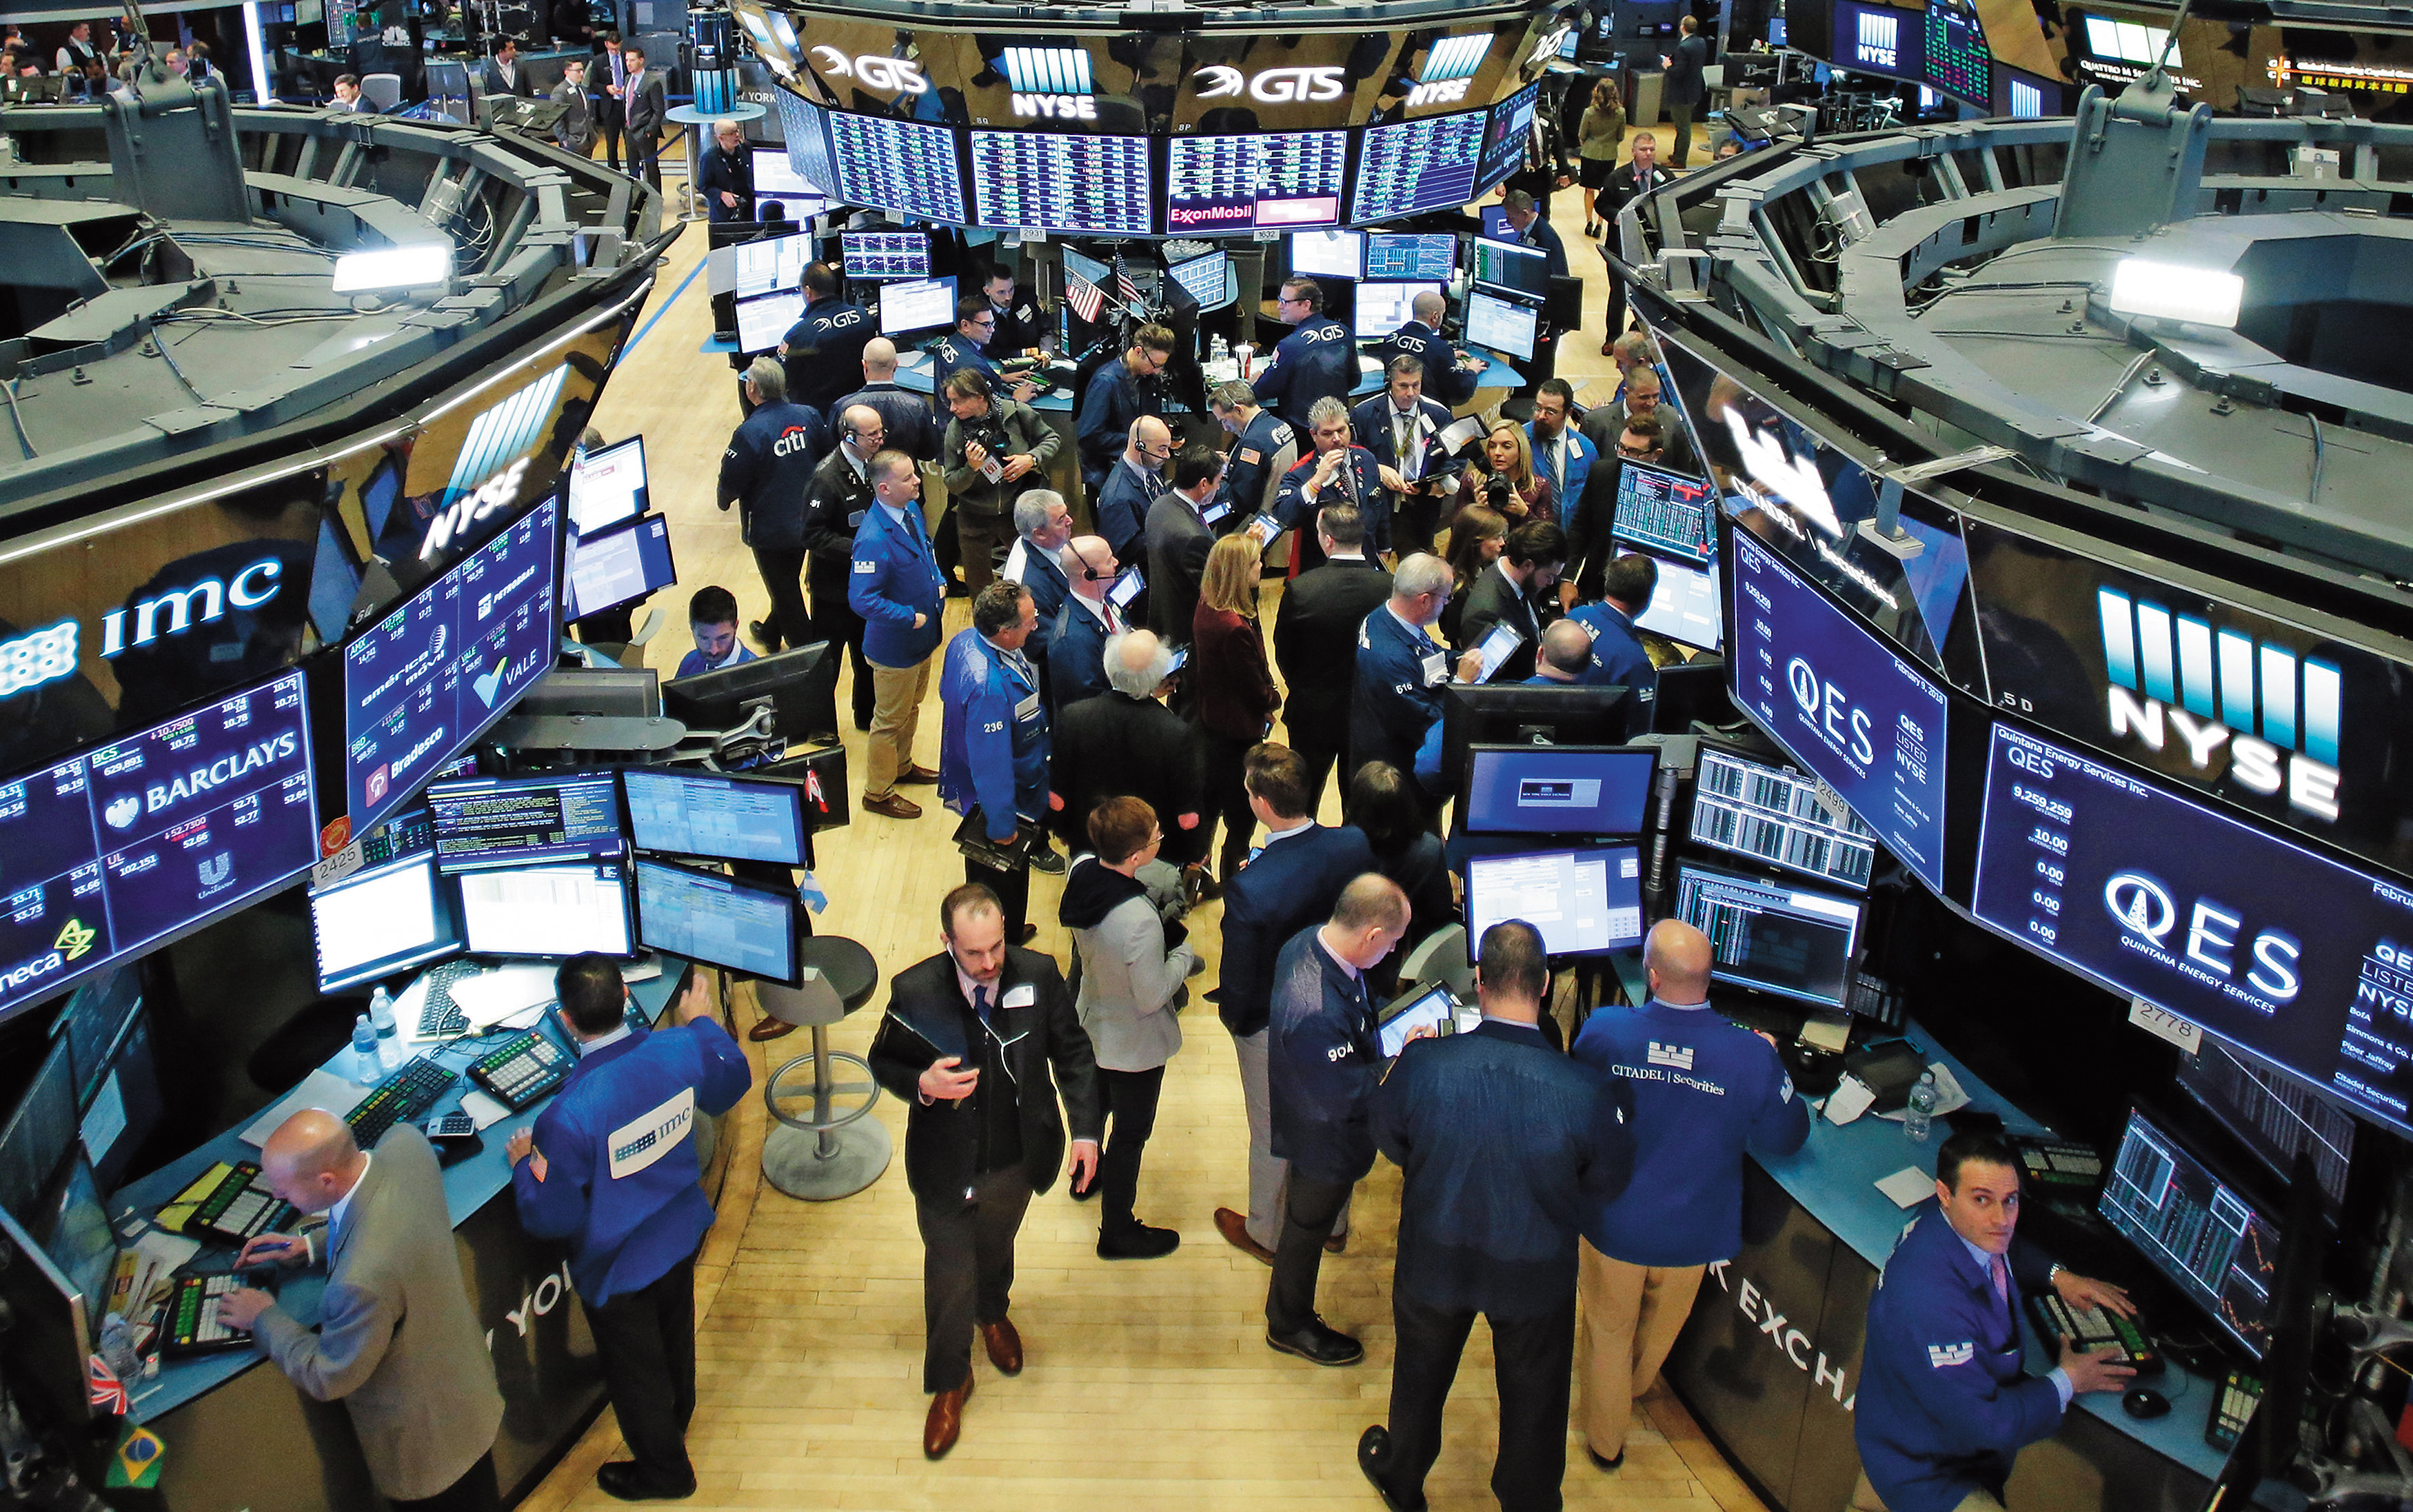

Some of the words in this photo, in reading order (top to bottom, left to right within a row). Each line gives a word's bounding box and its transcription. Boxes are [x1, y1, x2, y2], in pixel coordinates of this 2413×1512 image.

[1858, 44, 1897, 67] NYSE
[855, 54, 928, 94] GTS
[1249, 66, 1346, 101] GTS
[748, 91, 776, 103] YORK
[1406, 78, 1471, 106] NYSE
[1011, 92, 1097, 119] NYSE
[1170, 204, 1253, 224] ExxonMobil
[833, 310, 860, 327] GTS
[1320, 324, 1344, 341] GTS
[941, 343, 960, 364] GTS
[1397, 336, 1426, 353] GTS
[774, 430, 806, 457] citi
[419, 457, 529, 560] NYSE
[1730, 475, 1806, 541] CITADEL
[1816, 538, 1898, 610] Securities
[1740, 546, 1761, 574] QES
[1756, 618, 1772, 638] 10.00
[350, 637, 367, 656] AMX
[1759, 648, 1773, 665] 0.00
[506, 648, 537, 685] VALE
[1895, 659, 1920, 687] February
[273, 677, 298, 694] 10.75
[1760, 675, 1773, 692] 0.00
[221, 696, 247, 713] 10.74
[274, 693, 299, 709] 10.71
[1760, 701, 1773, 718] 0.00
[1788, 657, 1875, 765] QES
[157, 716, 194, 738] 10.7500
[223, 713, 249, 729] 10.78
[984, 720, 1004, 733] 236
[1900, 714, 1924, 742] QES
[169, 734, 196, 751] 10.72
[1896, 731, 1927, 763] LISTED
[2108, 683, 2341, 819] NYSE
[91, 747, 119, 765] BCS
[391, 727, 443, 780] Bradesco
[1998, 728, 2043, 754] Quintana
[2045, 747, 2081, 770] Energy
[2083, 763, 2126, 789] Services
[2129, 782, 2148, 798] Inc.
[2008, 746, 2054, 779] QES
[52, 760, 81, 778] 39.32
[103, 755, 143, 776] 629,891
[147, 732, 296, 814] BARCLAYS
[1897, 749, 1926, 785] NYSE
[56, 778, 84, 795] 39.19
[283, 772, 307, 789] 52.74
[232, 794, 259, 811] 52.71
[283, 789, 307, 805] 52.64
[1819, 783, 1845, 812] 2499
[2013, 785, 2072, 818] 9,259,259
[170, 816, 206, 837] 52.7300
[234, 809, 259, 827] 52.77
[183, 831, 209, 849] 52.66
[2035, 828, 2068, 851] 10.00
[108, 853, 125, 865] UL
[119, 854, 158, 877] 102,151
[319, 847, 356, 880] 2425
[2037, 861, 2064, 881] 0.00
[12, 887, 40, 906] 33.71
[72, 878, 101, 897] 33.66
[2034, 891, 2060, 911] 0.00
[14, 903, 43, 923] 33.73
[2030, 920, 2056, 940] 0.00
[2105, 874, 2299, 998] QES
[2375, 945, 2413, 971] QE
[2121, 936, 2175, 967] QUINTANA
[2178, 962, 2222, 987] ENERGY
[2223, 983, 2275, 1014] SERVICES
[2140, 1002, 2192, 1037] 2778
[2349, 1006, 2371, 1022] BofA
[2345, 1023, 2385, 1047] Simmons
[2385, 1042, 2393, 1051] &
[2394, 1046, 2409, 1058] Co.
[1328, 1042, 1354, 1062] 904
[2341, 1040, 2365, 1056] Piper
[2365, 1052, 2395, 1071] Jaffray
[1612, 1064, 1665, 1081] CITADEL
[1673, 1073, 1726, 1096] Securities
[2334, 1071, 2365, 1091] Citadel
[2365, 1086, 2407, 1111] Securities
[658, 1107, 690, 1140] imc
